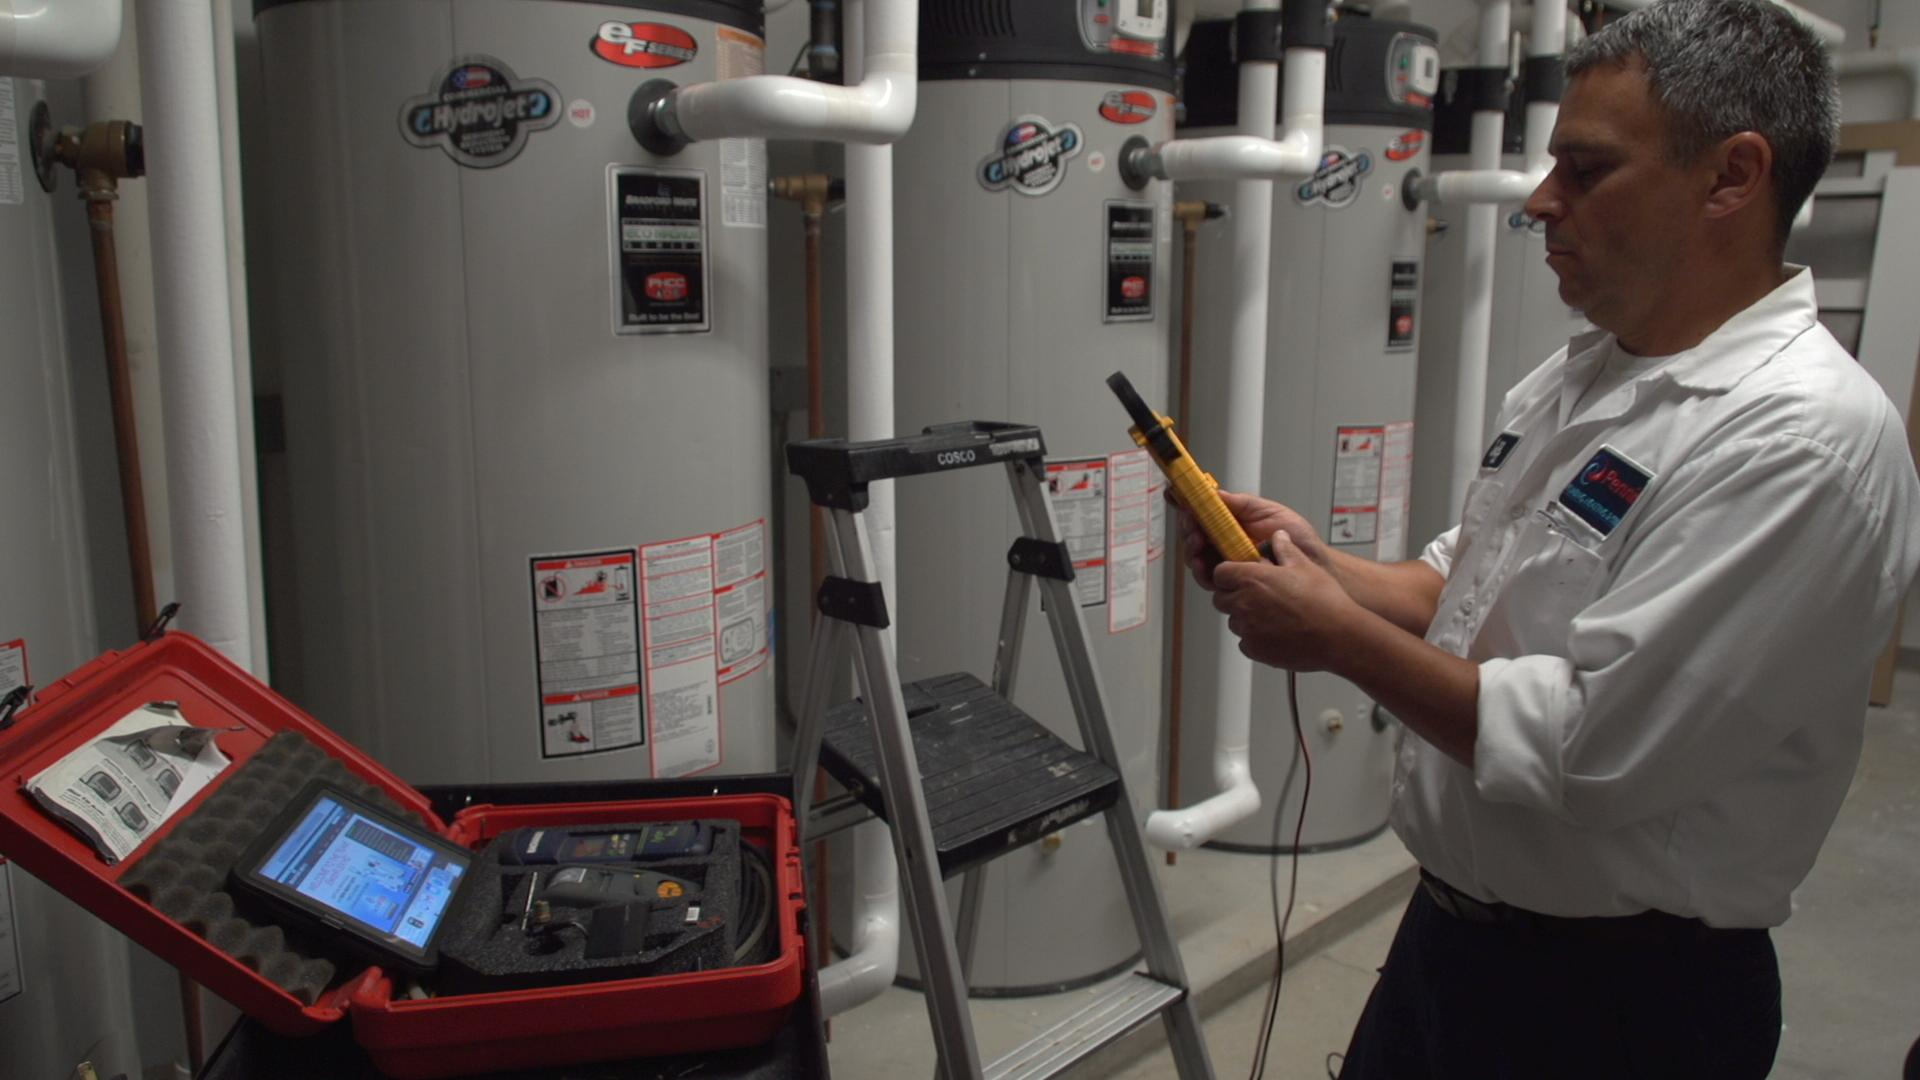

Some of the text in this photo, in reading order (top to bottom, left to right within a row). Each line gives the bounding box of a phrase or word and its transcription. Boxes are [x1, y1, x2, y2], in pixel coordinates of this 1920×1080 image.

[433, 95, 526, 132] Hydrojet
[572, 109, 591, 120] HOT
[937, 449, 976, 465] COSCO
